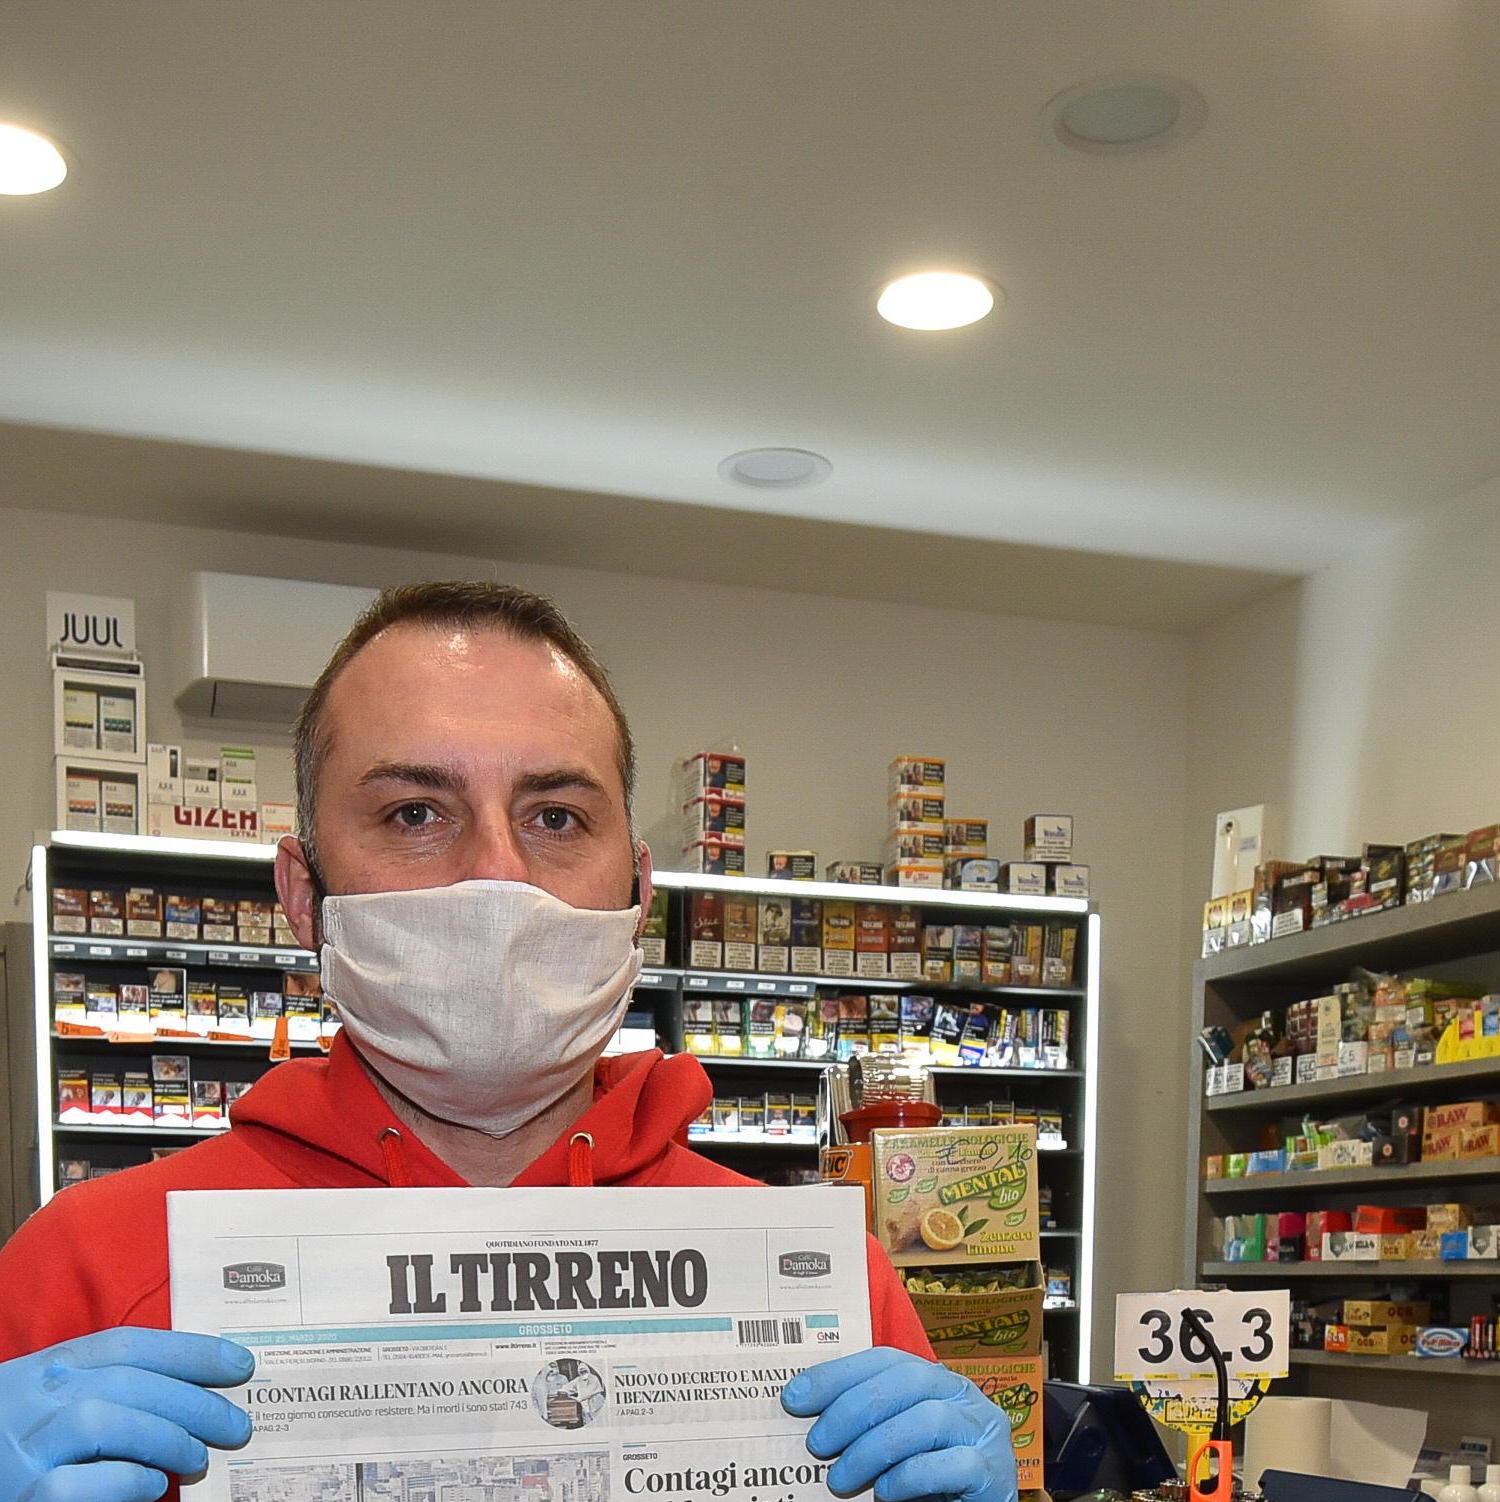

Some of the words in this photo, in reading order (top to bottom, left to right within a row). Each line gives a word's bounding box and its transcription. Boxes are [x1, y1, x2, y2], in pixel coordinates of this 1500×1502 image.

[60, 612, 123, 648] JUUL
[940, 1162, 1027, 1202] MENTAL
[1000, 1188, 1020, 1204] bio
[966, 1244, 1016, 1255] Limone
[386, 1254, 446, 1315] IL
[449, 1249, 708, 1313] TIRRENO
[518, 1323, 572, 1336] GROSSETO
[615, 1373, 668, 1387] NUOVO
[672, 1370, 737, 1385] DECRETO
[741, 1370, 749, 1382] E
[752, 1368, 787, 1382] MAXI
[248, 1390, 252, 1404] I
[256, 1385, 336, 1404] CONTAGI
[339, 1381, 454, 1401] RALLENTANO
[458, 1378, 528, 1395] ANCORA
[624, 1462, 736, 1496] Contagi
[743, 1463, 834, 1488] ancor
